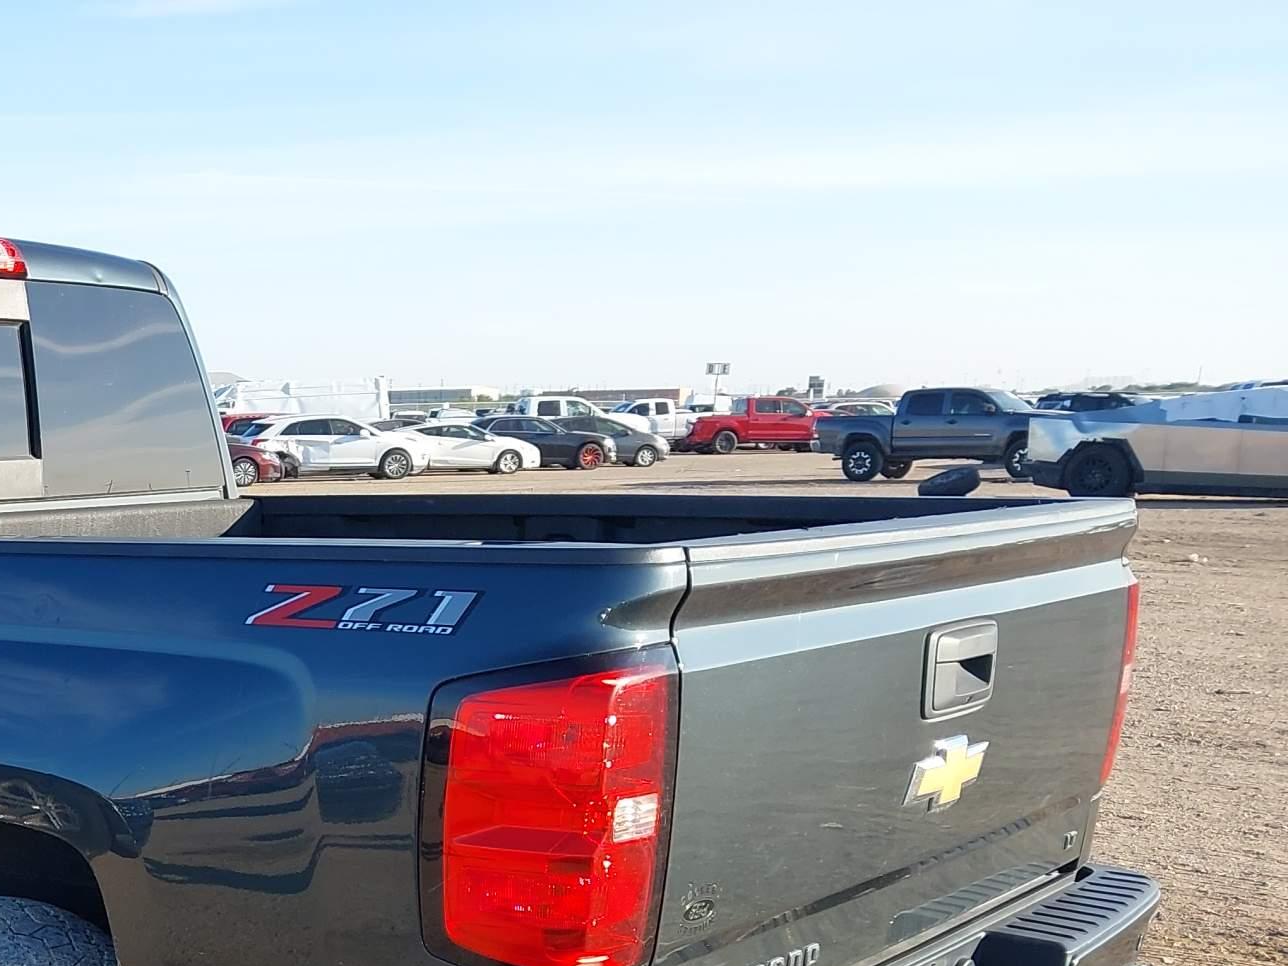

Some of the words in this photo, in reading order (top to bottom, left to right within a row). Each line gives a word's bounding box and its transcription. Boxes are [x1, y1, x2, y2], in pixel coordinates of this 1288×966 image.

[245, 584, 478, 629] Z71
[337, 621, 382, 631] OFF
[385, 623, 454, 635] ROAD
